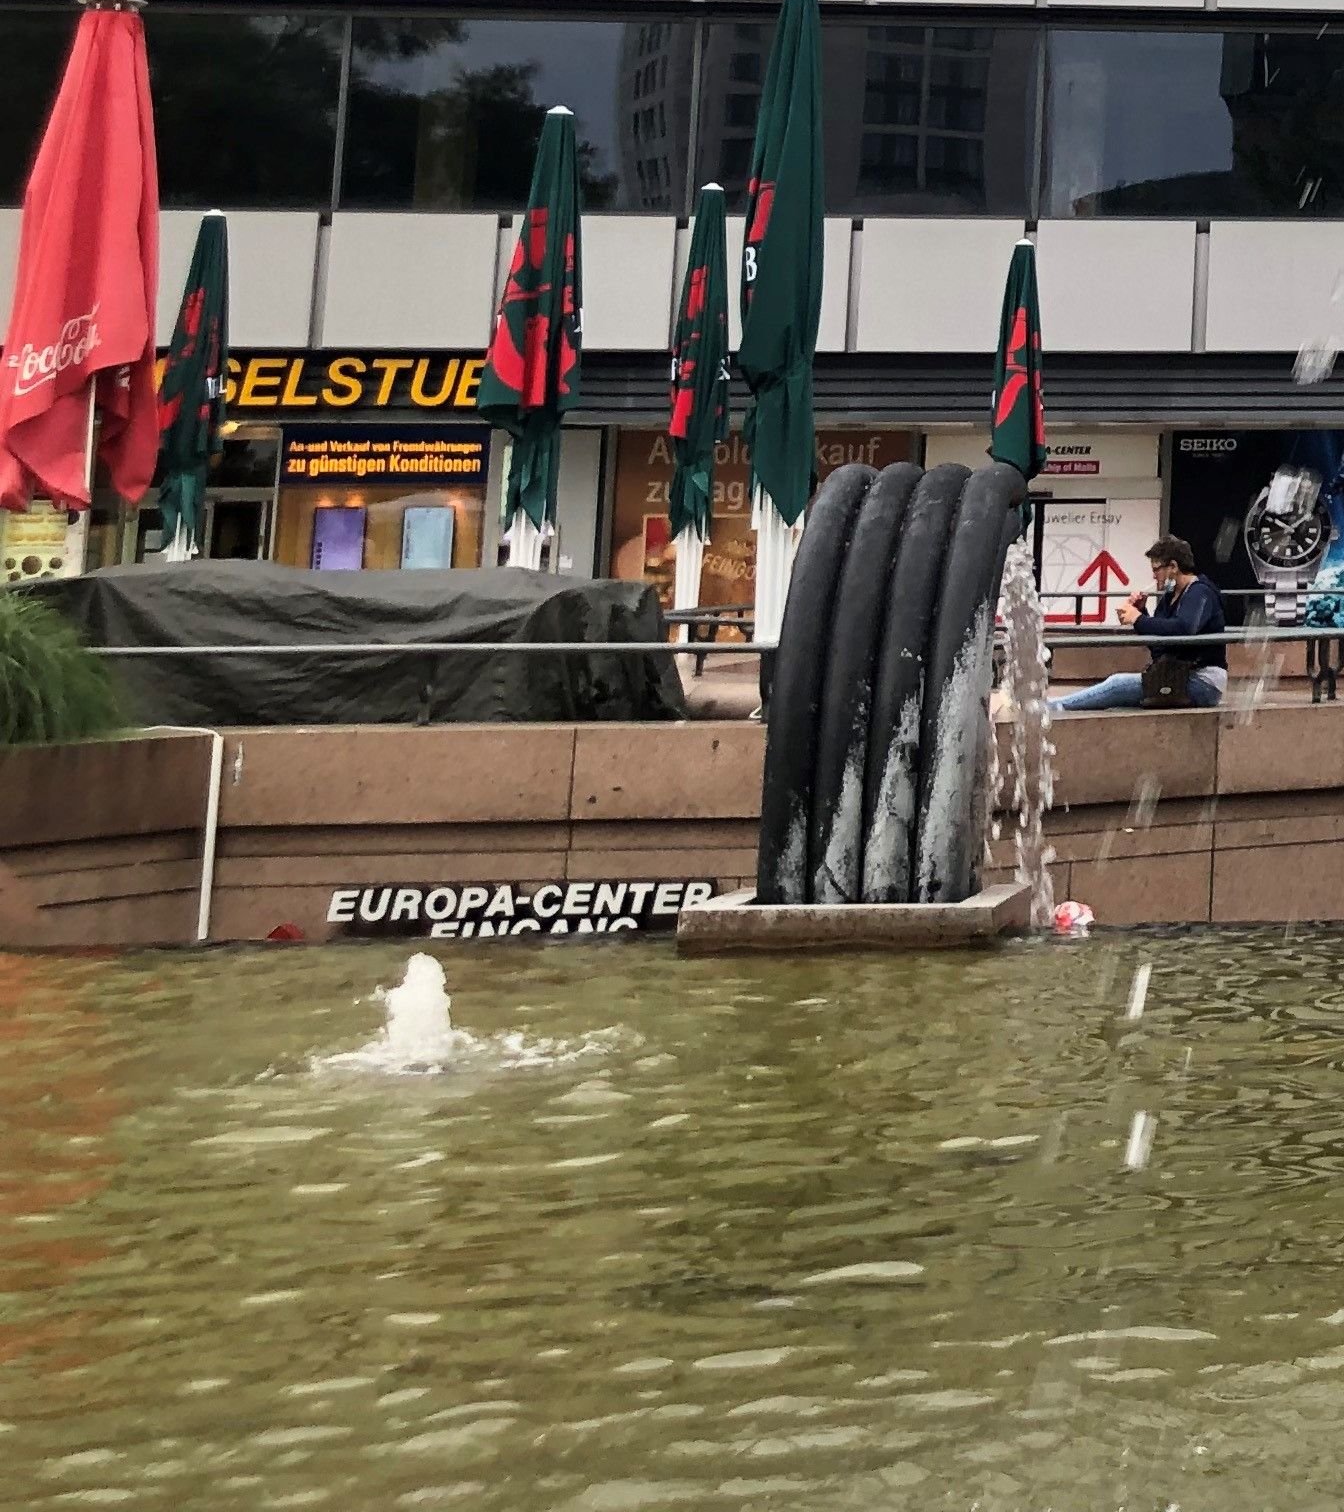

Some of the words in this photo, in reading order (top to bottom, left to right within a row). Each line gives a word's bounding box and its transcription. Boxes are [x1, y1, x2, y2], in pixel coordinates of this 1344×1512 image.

[1180, 438, 1238, 451] SEIKO
[287, 458, 306, 473] zu
[309, 454, 385, 476] günstigen
[389, 454, 482, 473] Konditionen
[326, 882, 713, 923] EUROPA-CENTER
